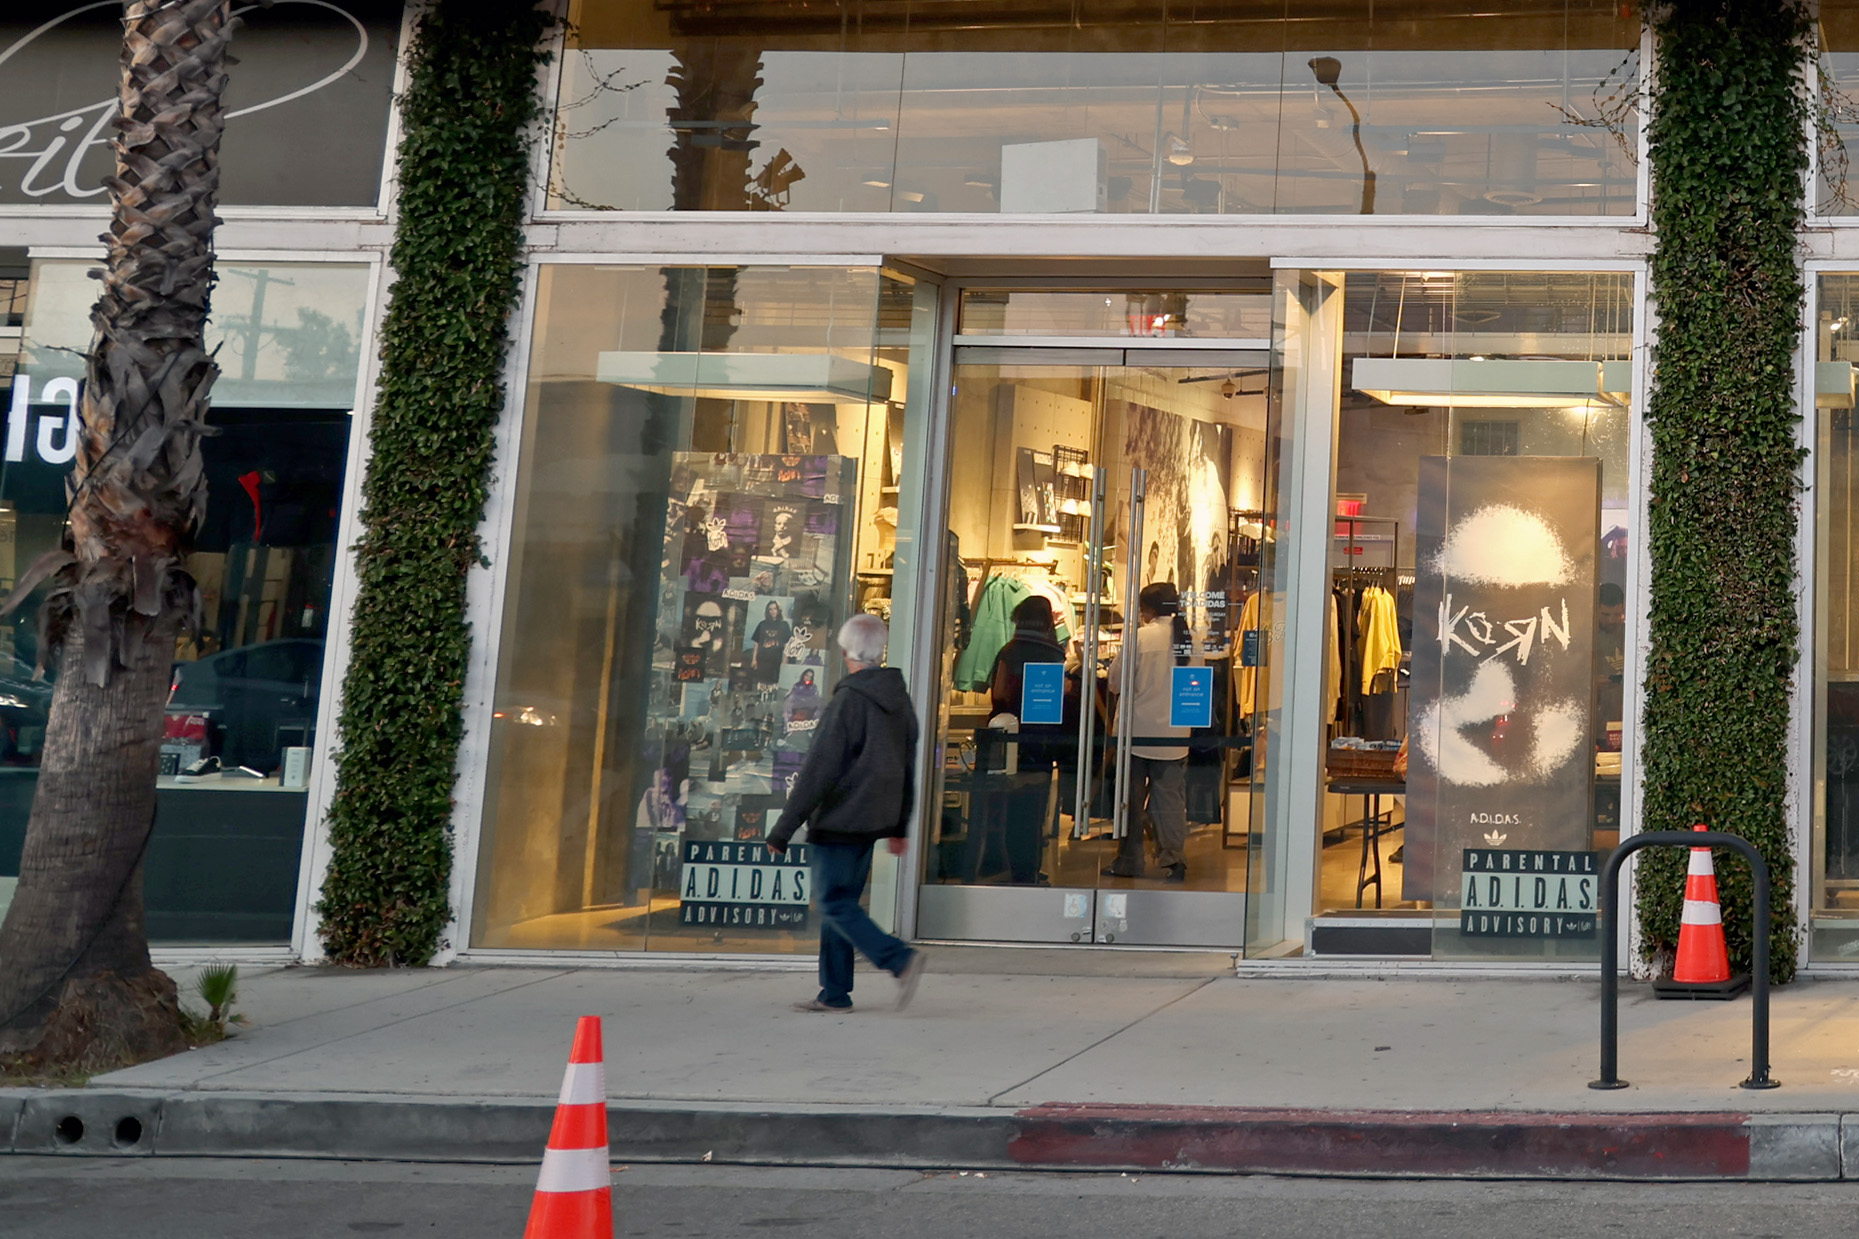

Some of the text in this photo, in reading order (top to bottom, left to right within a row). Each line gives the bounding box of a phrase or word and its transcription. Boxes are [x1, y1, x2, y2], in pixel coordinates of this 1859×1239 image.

[1180, 600, 1194, 608] TO
[1181, 591, 1225, 600] WELCOME
[1470, 853, 1592, 872] PARENTAL
[685, 867, 806, 902] A.D.I.D.A.S.
[1466, 875, 1593, 910] A.D.I.D.A.S.
[684, 906, 777, 925] ADVISORY
[1467, 915, 1563, 934] ADVISORY
